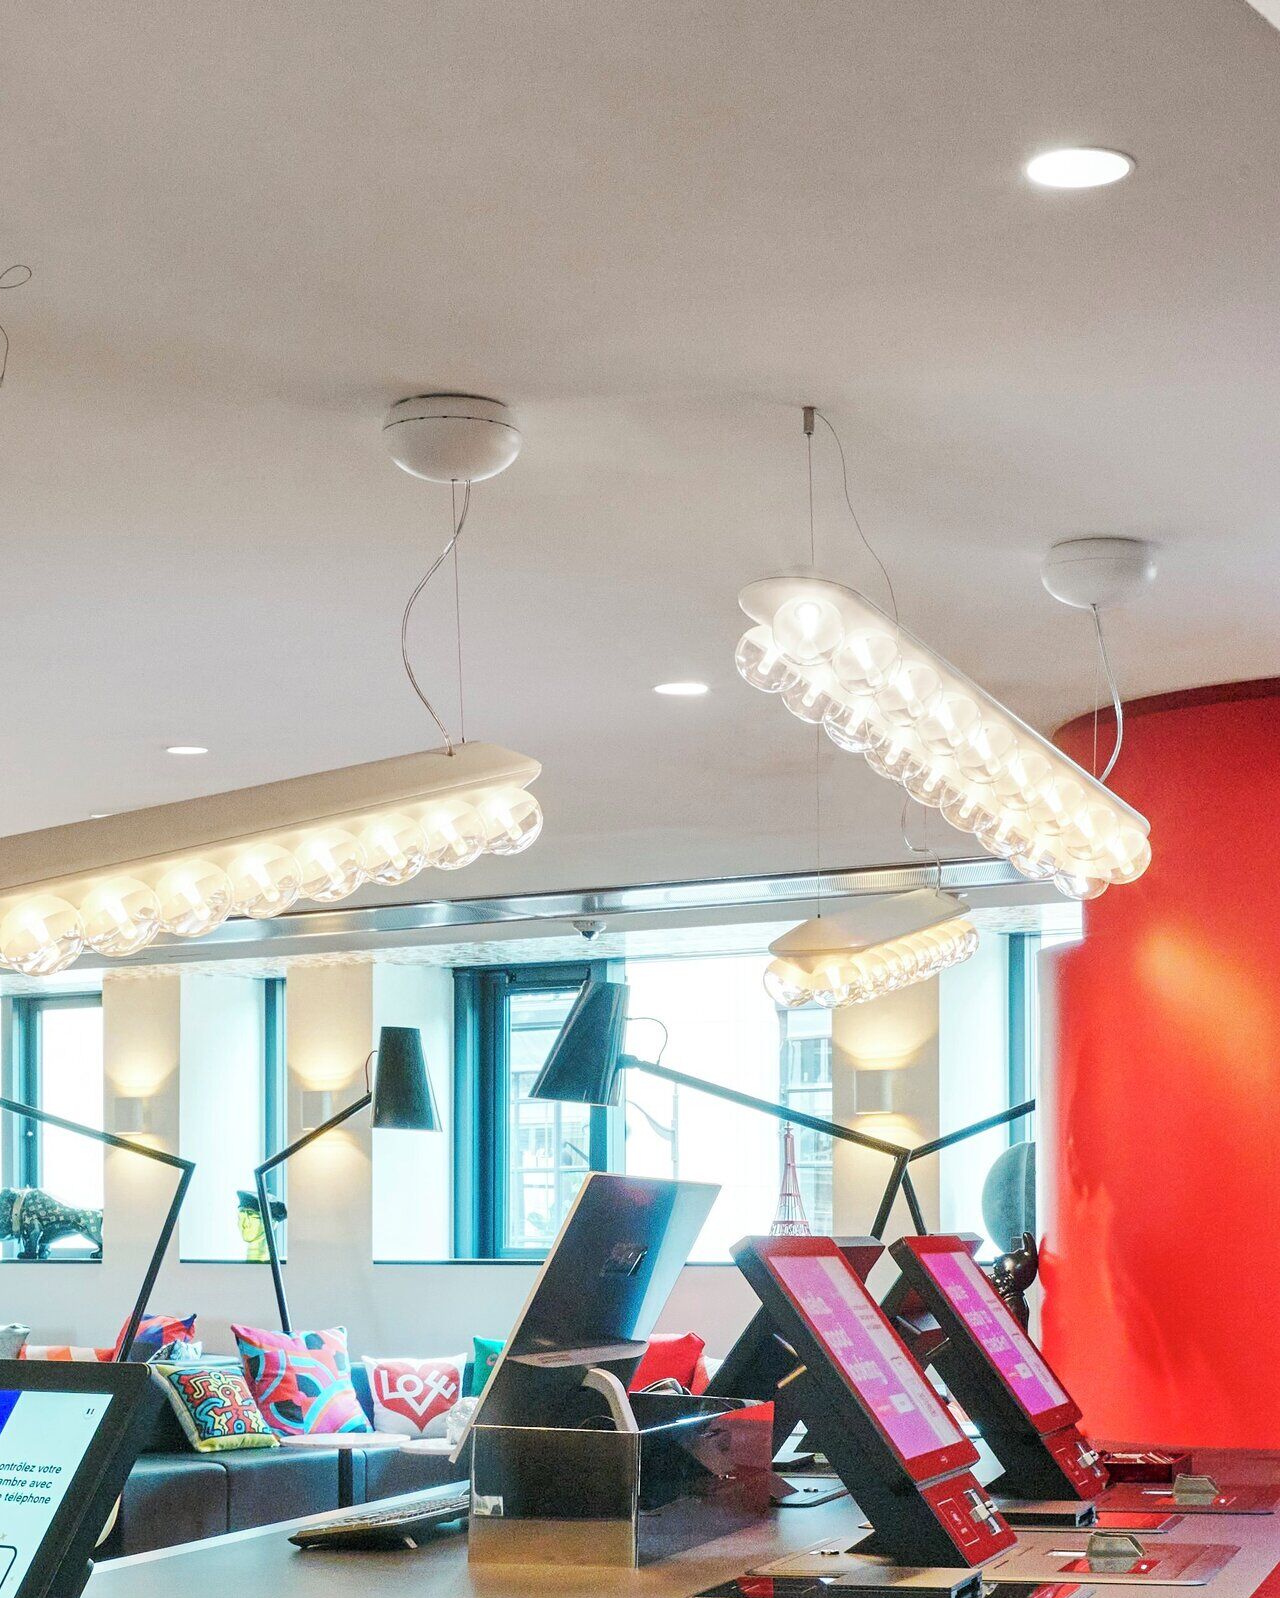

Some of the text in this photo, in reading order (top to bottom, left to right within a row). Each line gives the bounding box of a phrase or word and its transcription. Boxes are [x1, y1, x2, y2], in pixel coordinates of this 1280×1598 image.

[380, 1369, 457, 1417] LOVE
[38, 1465, 62, 1474] votre
[29, 1480, 52, 1489] avec
[4, 1492, 51, 1505] téléphone
